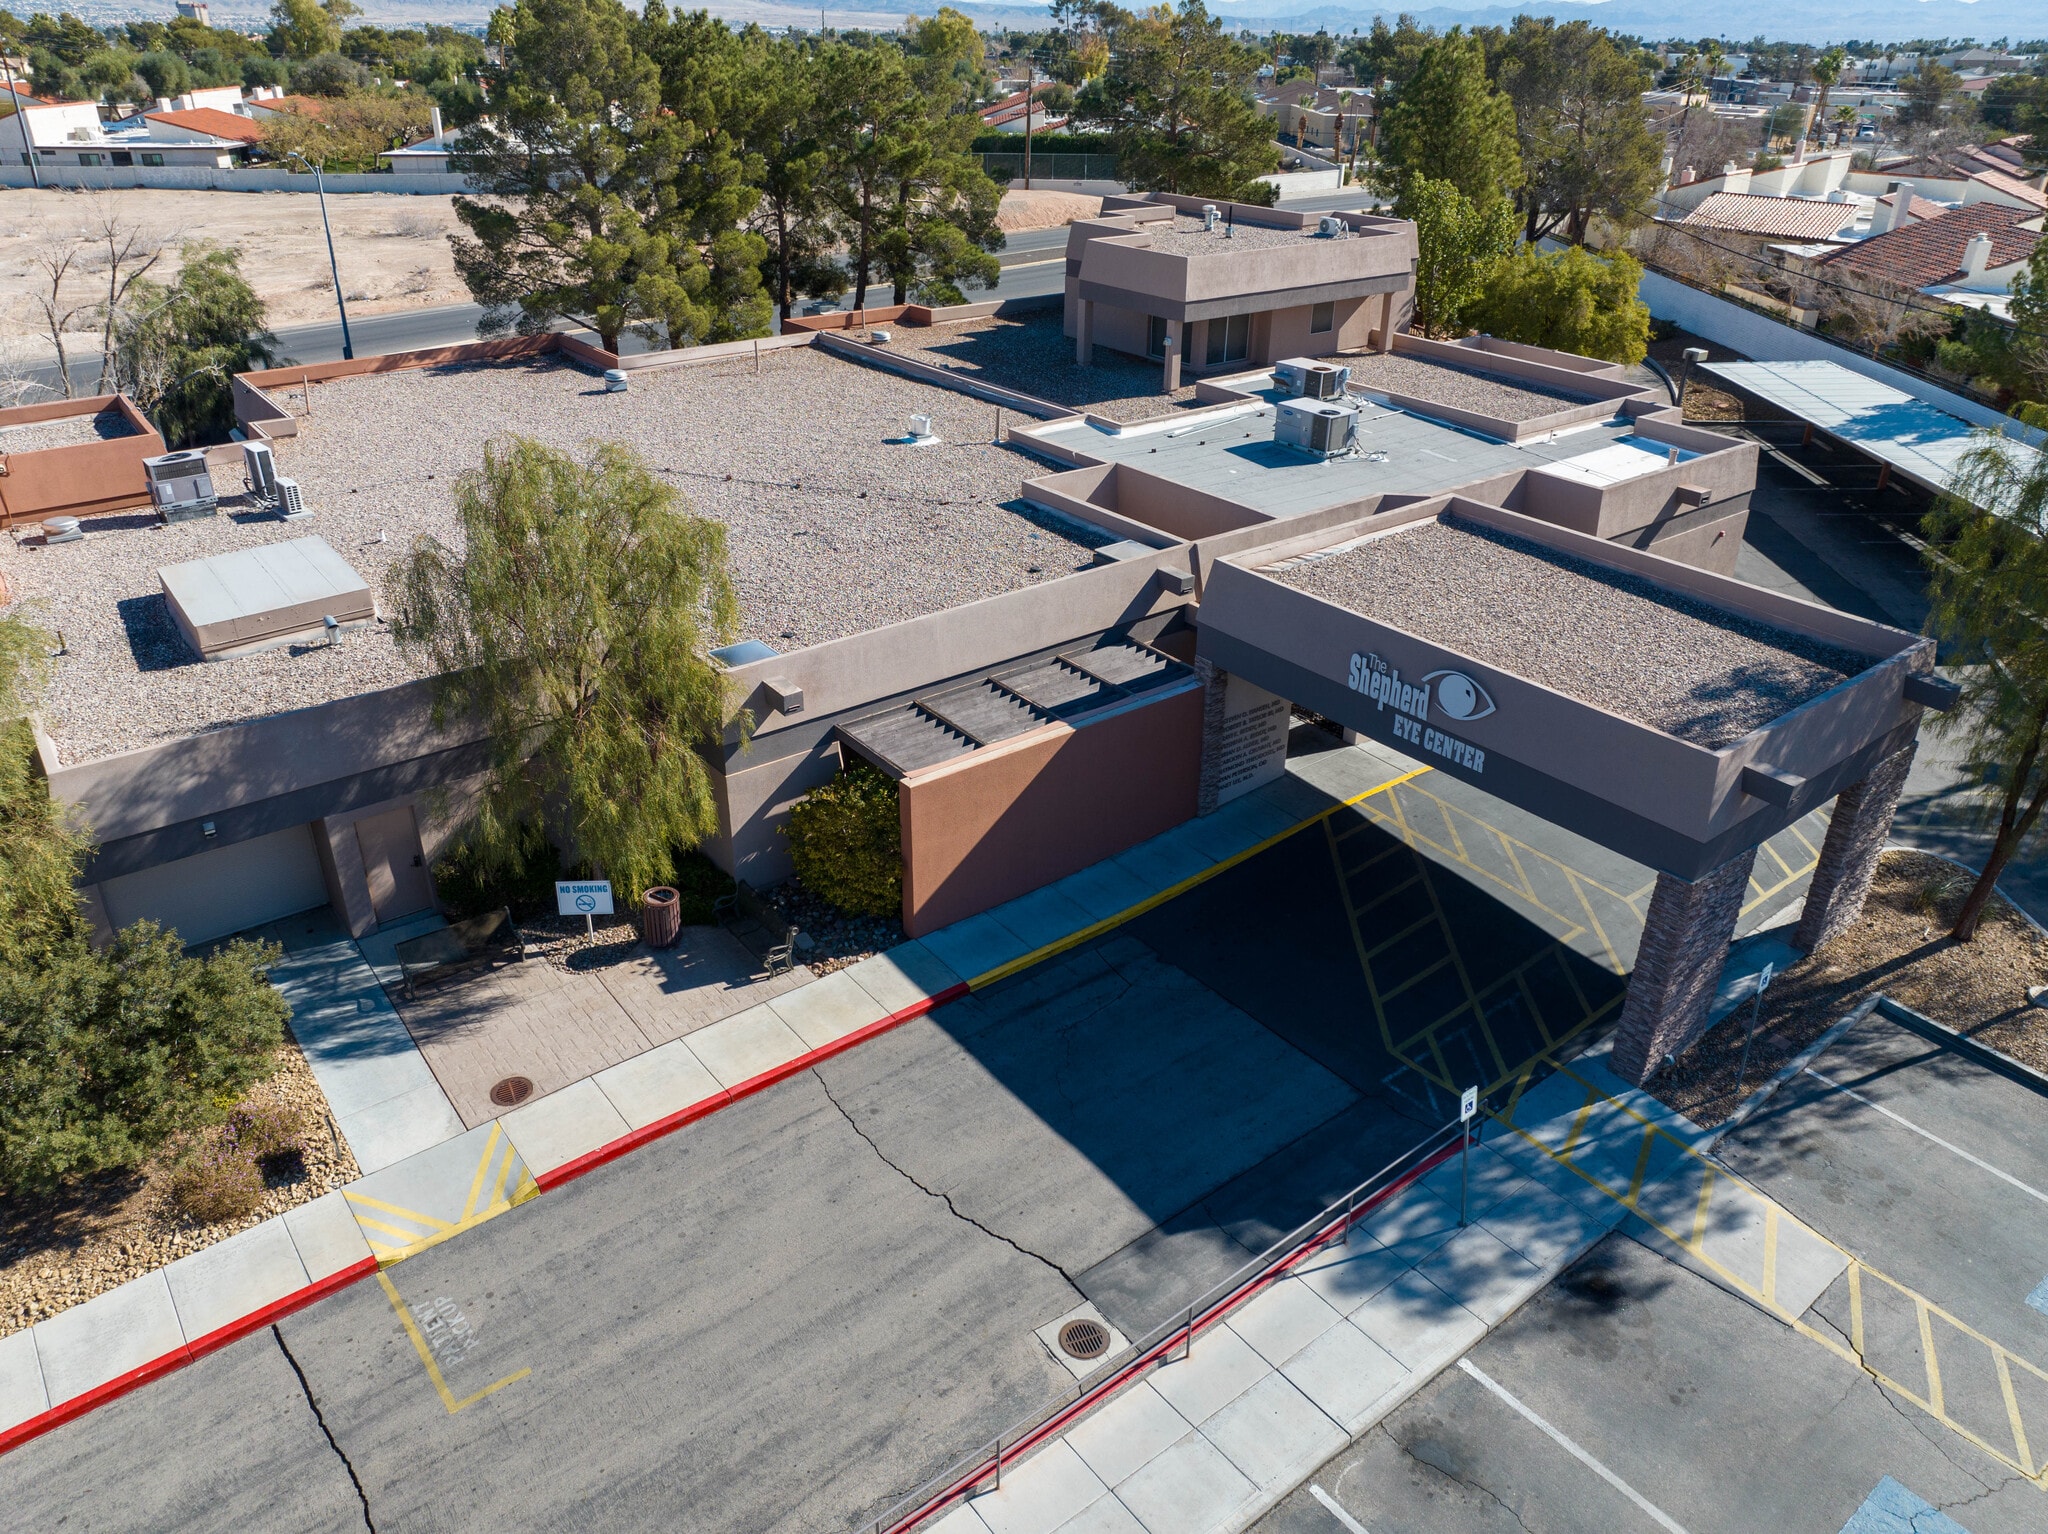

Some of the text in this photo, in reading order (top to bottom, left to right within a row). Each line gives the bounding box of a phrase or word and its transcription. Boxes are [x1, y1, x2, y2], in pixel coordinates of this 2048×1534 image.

[1369, 652, 1387, 674] The
[1348, 653, 1430, 721] Shepherd
[1393, 714, 1486, 773] EYE CENTER
[560, 885, 608, 893] NO SMOKING
